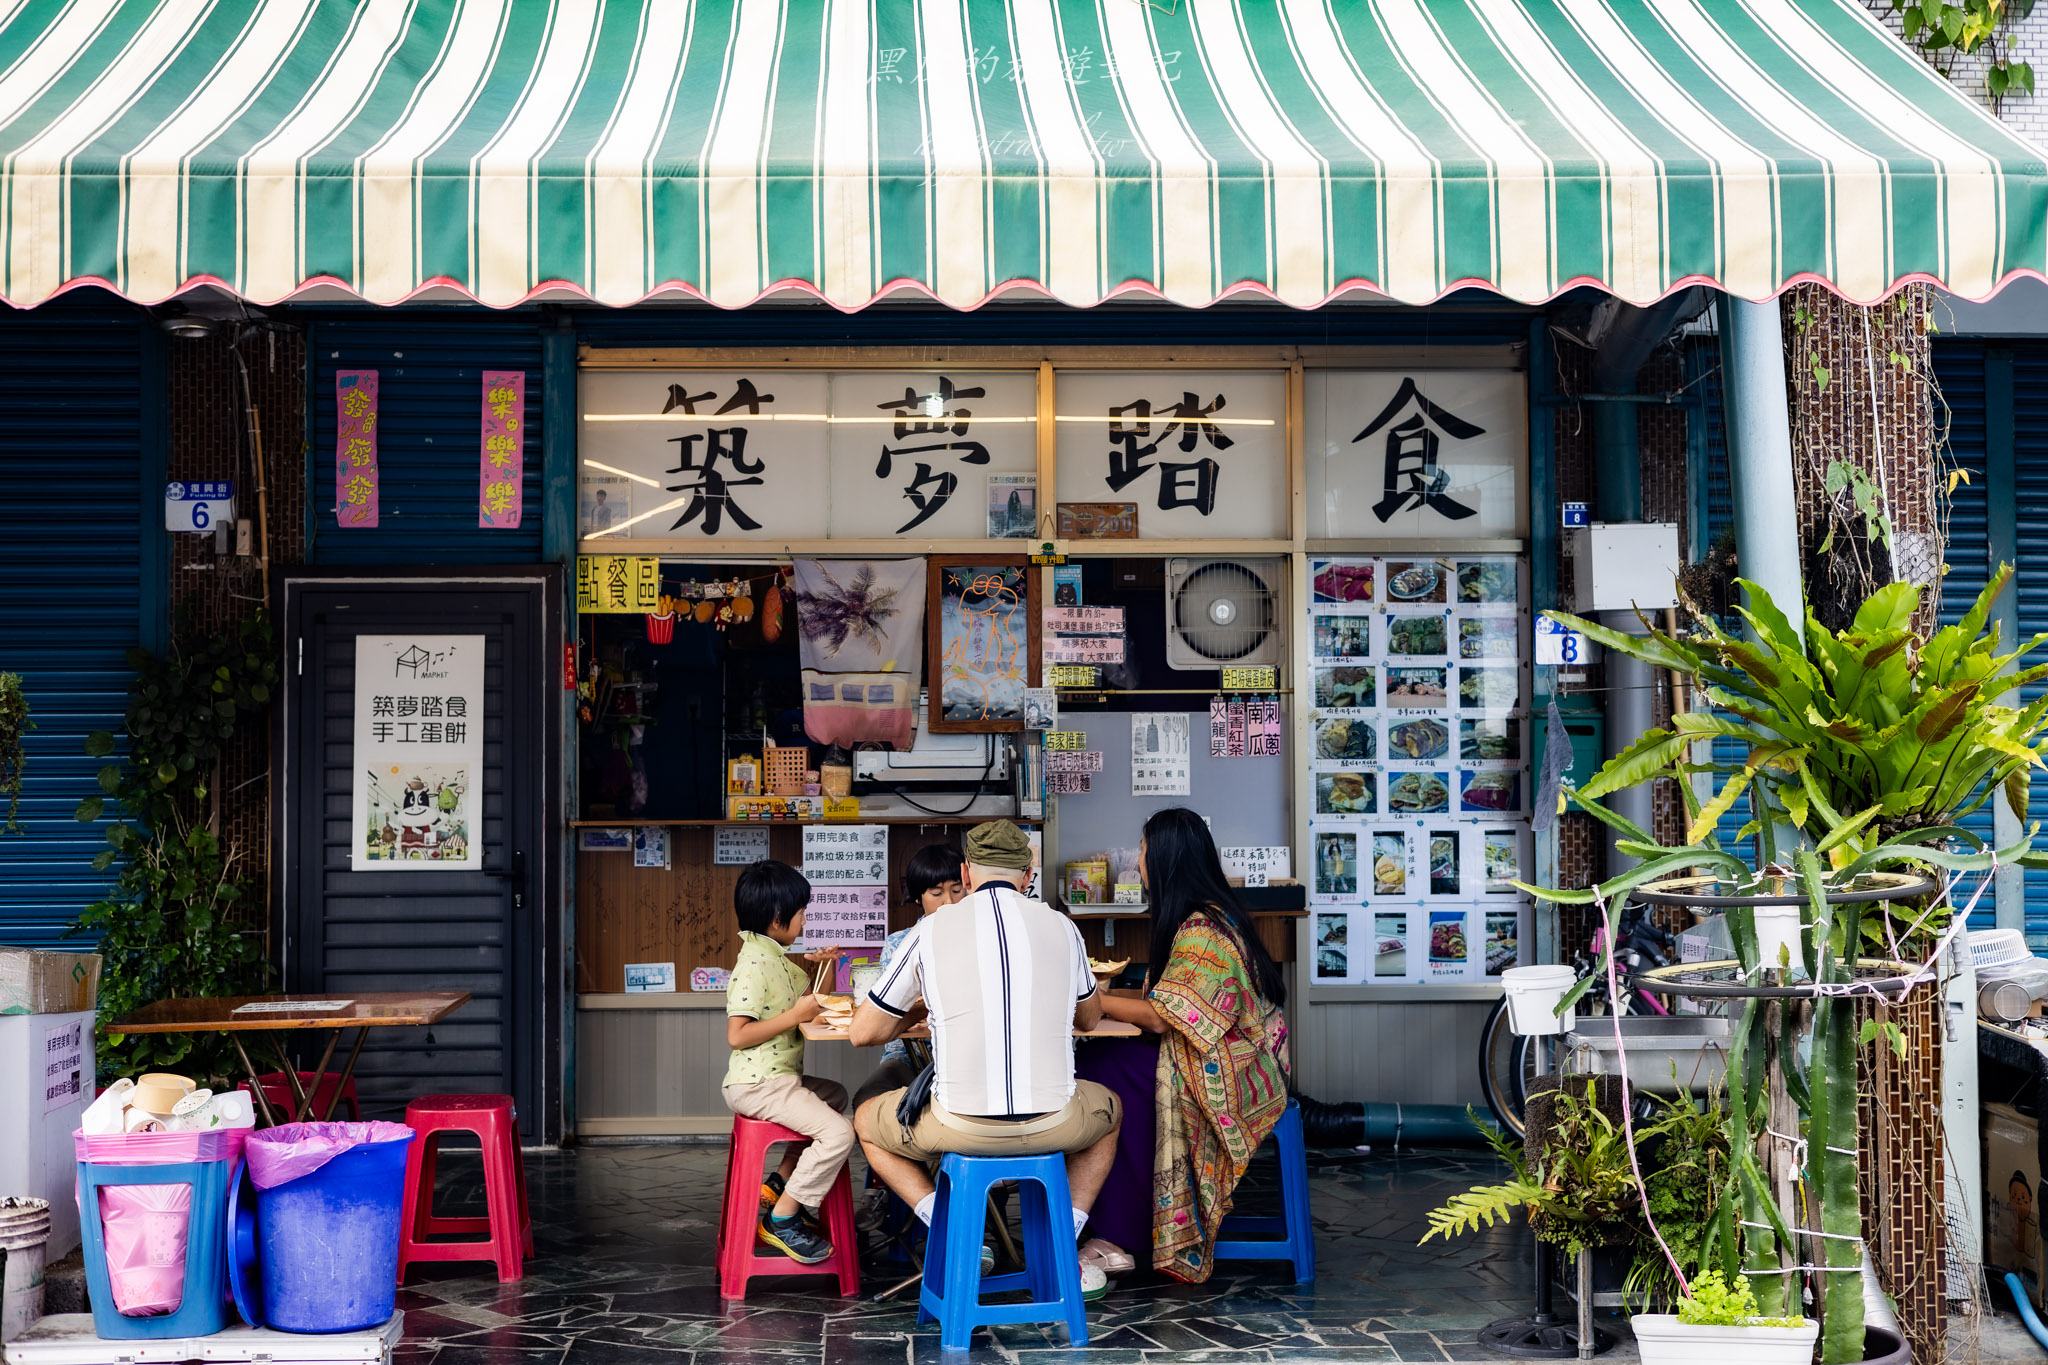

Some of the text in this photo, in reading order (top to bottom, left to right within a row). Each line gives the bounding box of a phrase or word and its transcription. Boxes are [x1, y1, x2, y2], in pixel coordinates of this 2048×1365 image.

[192, 502, 210, 529] 6
[1574, 513, 1581, 523] 8
[578, 557, 657, 609] 點餐區
[1561, 636, 1578, 662] 8
[372, 695, 467, 718] 築夢踏食
[372, 722, 467, 744] 手工蛋餅
[1211, 704, 1227, 756] 火龍果
[1228, 703, 1244, 756] 蜜香紅茶
[1247, 703, 1265, 756] 南瓜
[805, 832, 859, 843] 享用完美食
[805, 851, 884, 862] 請將垃圾分類丟棄
[806, 912, 885, 921] 也別忘了收拾好餐具
[805, 929, 865, 939] 感謝您的配合
